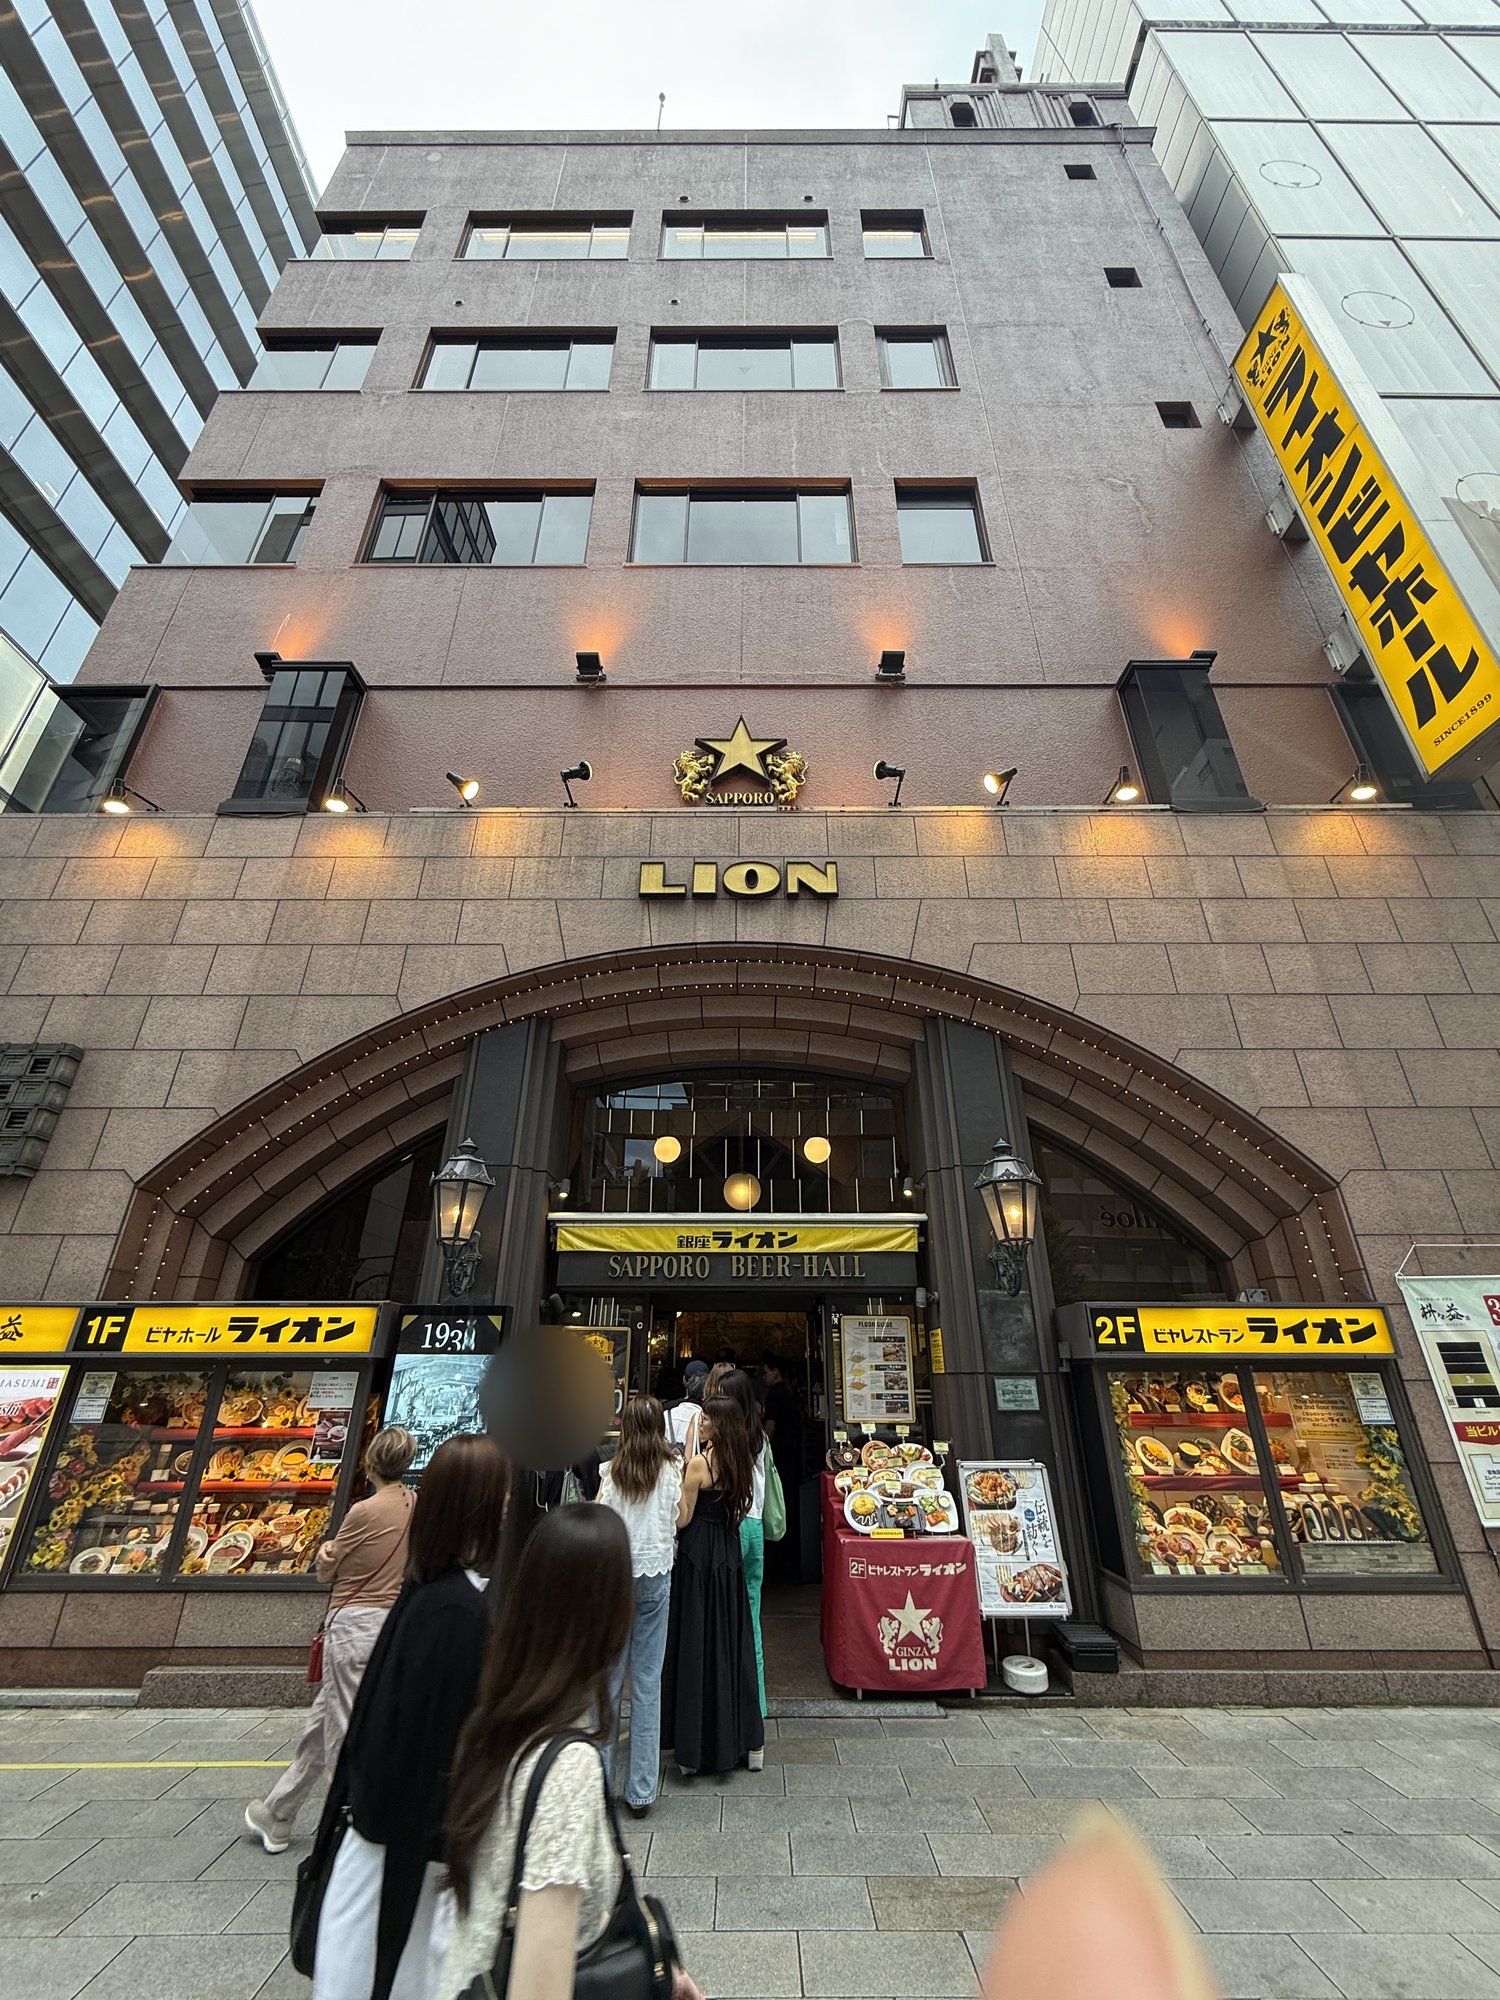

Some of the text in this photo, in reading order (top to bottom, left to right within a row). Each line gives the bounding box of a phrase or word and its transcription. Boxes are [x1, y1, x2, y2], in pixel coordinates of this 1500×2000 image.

[705, 792, 774, 805] SAPPORO
[638, 861, 840, 898] LION
[608, 1254, 867, 1279] SAPPORO BEER-HALL
[86, 1315, 126, 1345] 1F
[1095, 1316, 1136, 1345] 2F
[850, 1561, 866, 1575] 2F
[896, 1646, 929, 1657] GINZA
[888, 1657, 938, 1671] LION
